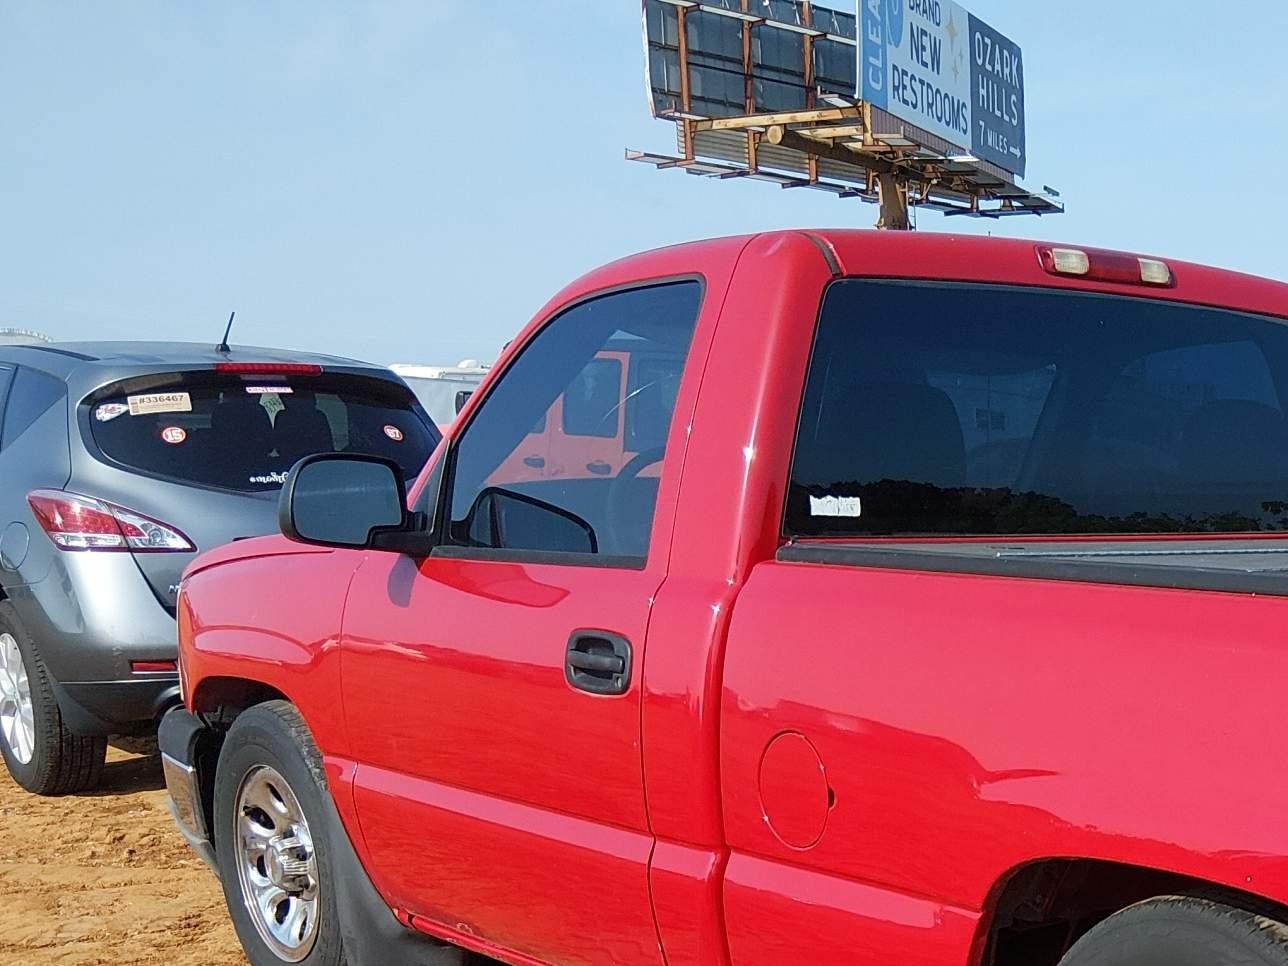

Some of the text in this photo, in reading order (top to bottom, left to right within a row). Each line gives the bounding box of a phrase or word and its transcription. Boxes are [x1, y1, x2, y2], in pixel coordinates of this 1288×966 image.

[910, 21, 942, 75] NEW
[974, 31, 1020, 89] OZARK
[892, 63, 968, 136] RESTROOMS
[978, 73, 1018, 127] HILLS
[979, 120, 1008, 154] 7 MILES
